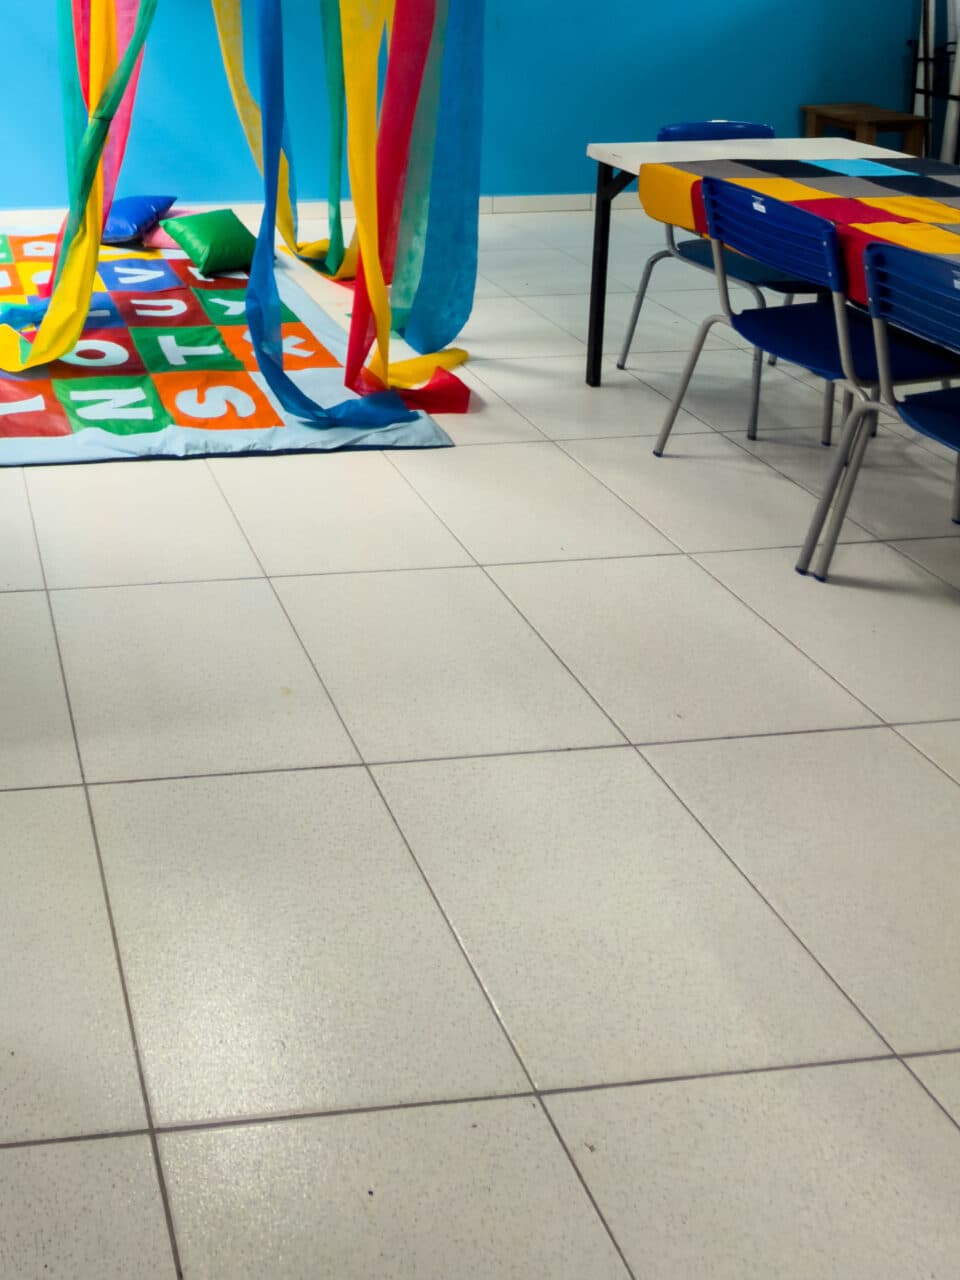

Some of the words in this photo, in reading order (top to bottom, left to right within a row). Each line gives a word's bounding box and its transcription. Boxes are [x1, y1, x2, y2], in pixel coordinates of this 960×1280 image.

[114, 266, 165, 284] V
[129, 299, 187, 317] U
[157, 335, 224, 365] T
[69, 387, 154, 420] N
[174, 385, 257, 418] S
